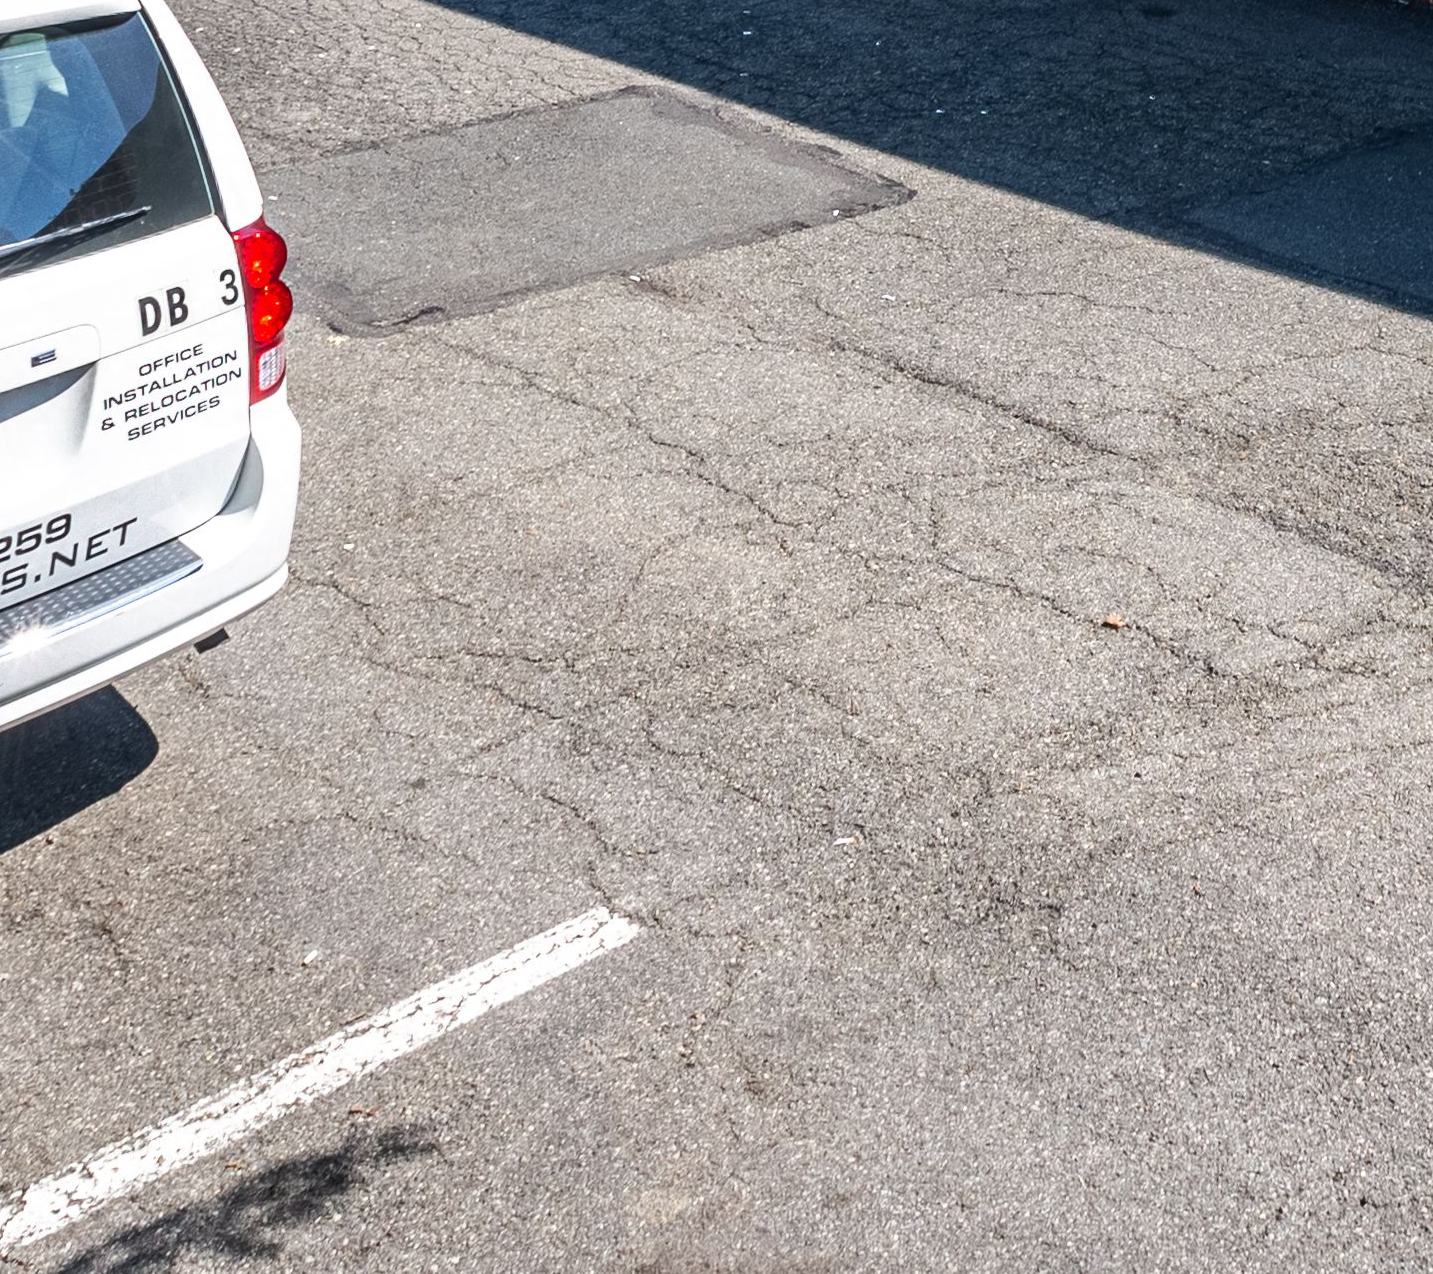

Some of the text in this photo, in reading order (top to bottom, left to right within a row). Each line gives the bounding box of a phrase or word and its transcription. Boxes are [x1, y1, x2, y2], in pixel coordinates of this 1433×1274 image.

[138, 268, 239, 337] DB 3
[103, 350, 238, 410] INSTALLATION
[138, 343, 204, 377] OFFICE
[101, 367, 242, 431] & RELOCATION
[127, 395, 221, 441] SERVICES
